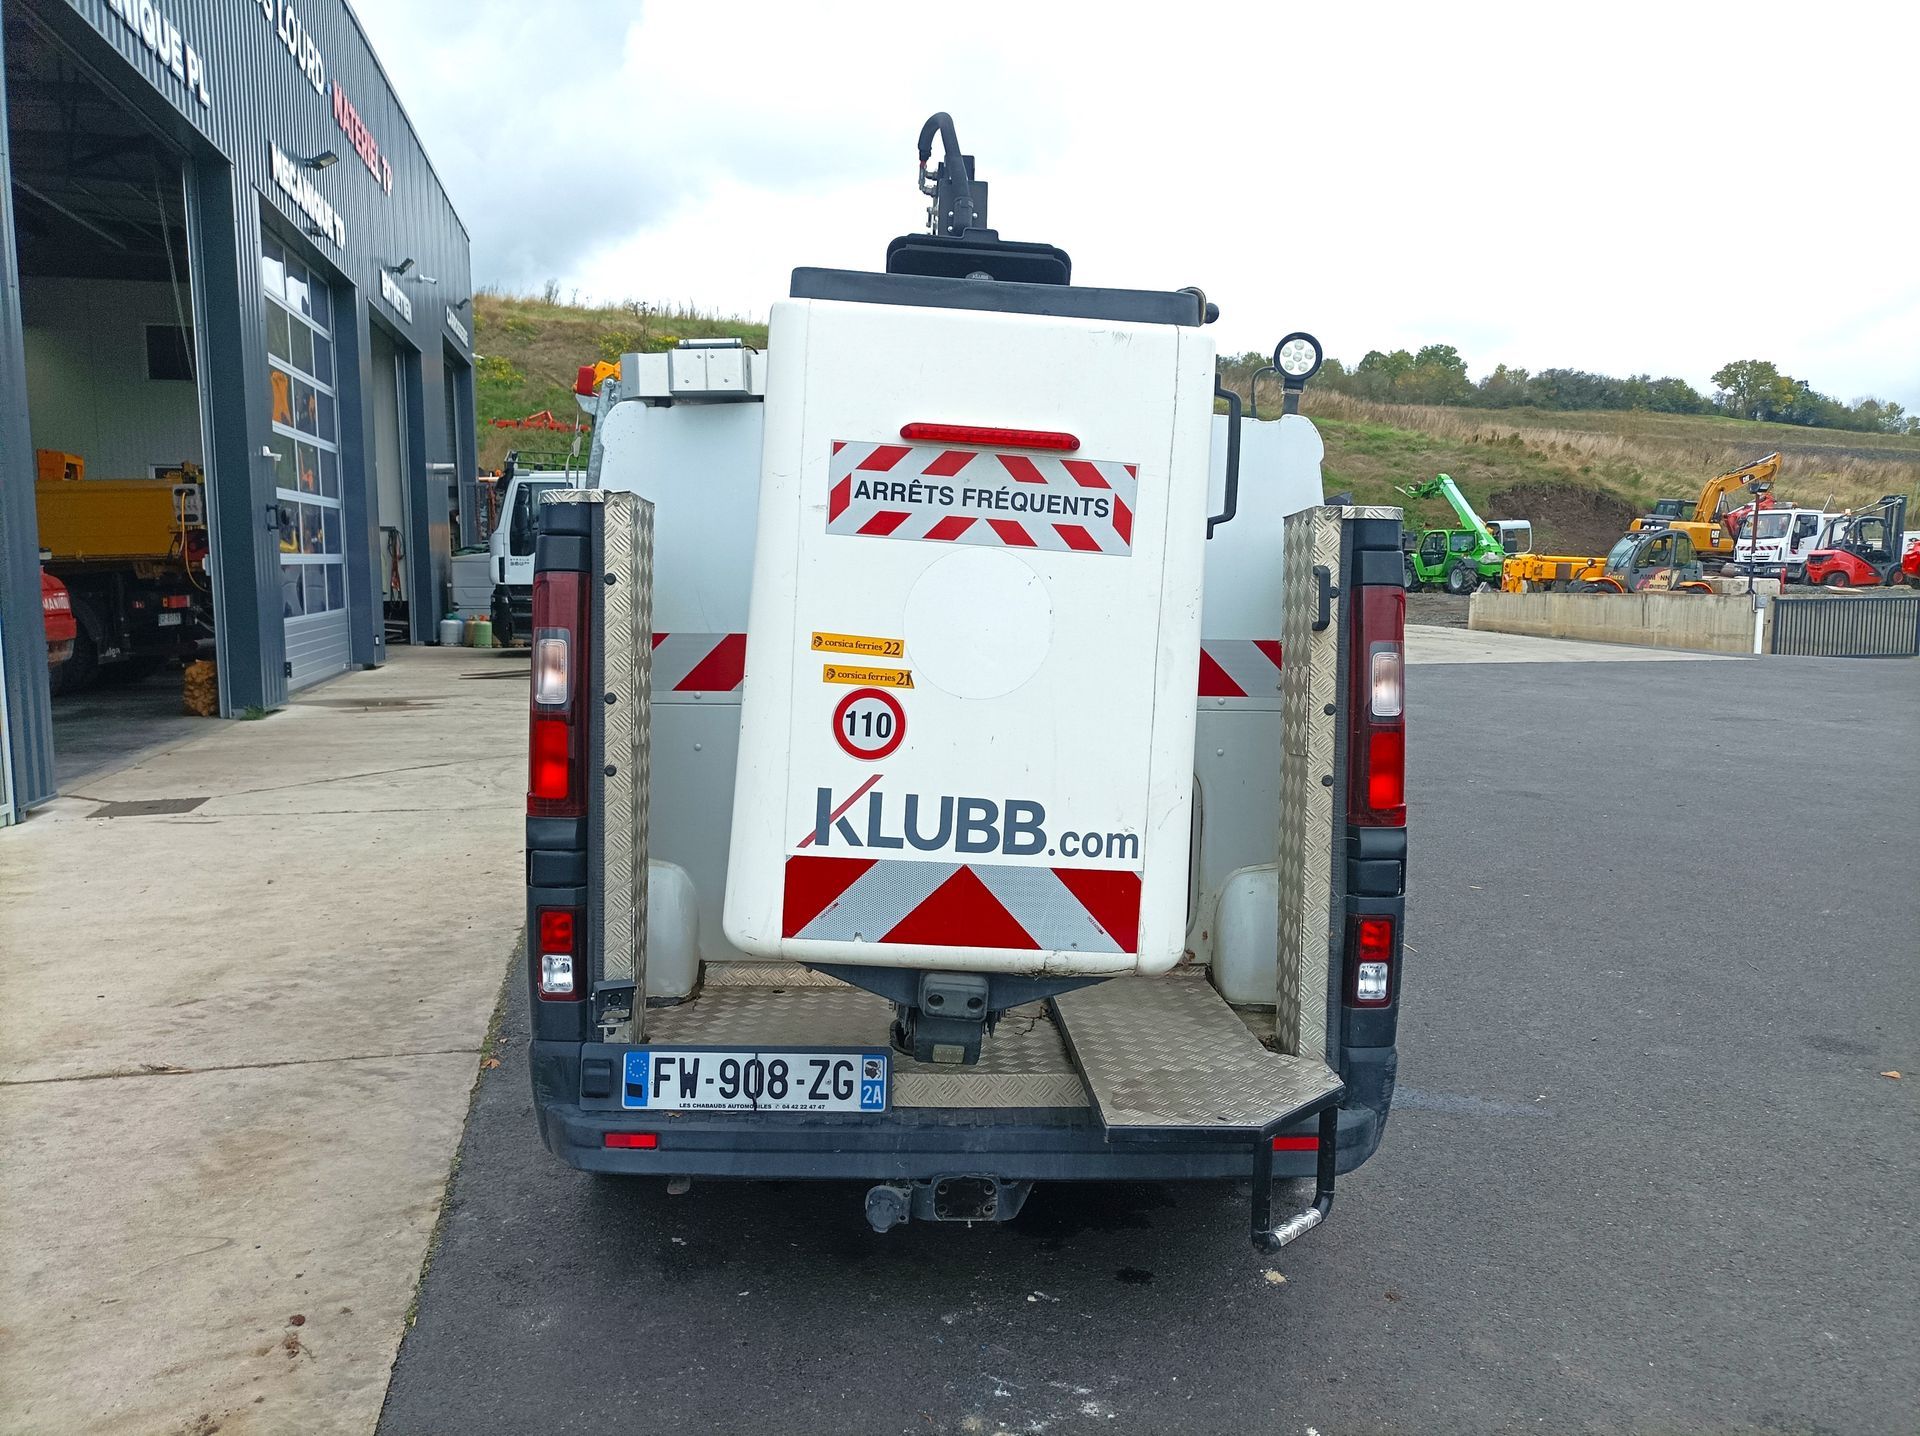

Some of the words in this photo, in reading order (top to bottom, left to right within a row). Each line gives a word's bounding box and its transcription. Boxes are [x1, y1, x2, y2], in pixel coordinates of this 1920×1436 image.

[276, 0, 325, 96] LOURD
[185, 41, 211, 110] PL
[332, 78, 381, 184] MATERIEL
[854, 479, 954, 506] ARRÊTS
[961, 486, 1110, 518] FRÉQUENTS
[825, 638, 854, 649] corsica
[855, 640, 883, 651] ferries
[882, 641, 901, 656] 22
[837, 671, 867, 681] corsica
[868, 671, 896, 683] ferries
[895, 672, 911, 686] 21
[845, 710, 892, 739] 110
[653, 1057, 855, 1101] FW-908-ZG
[863, 1085, 882, 1105] 2A
